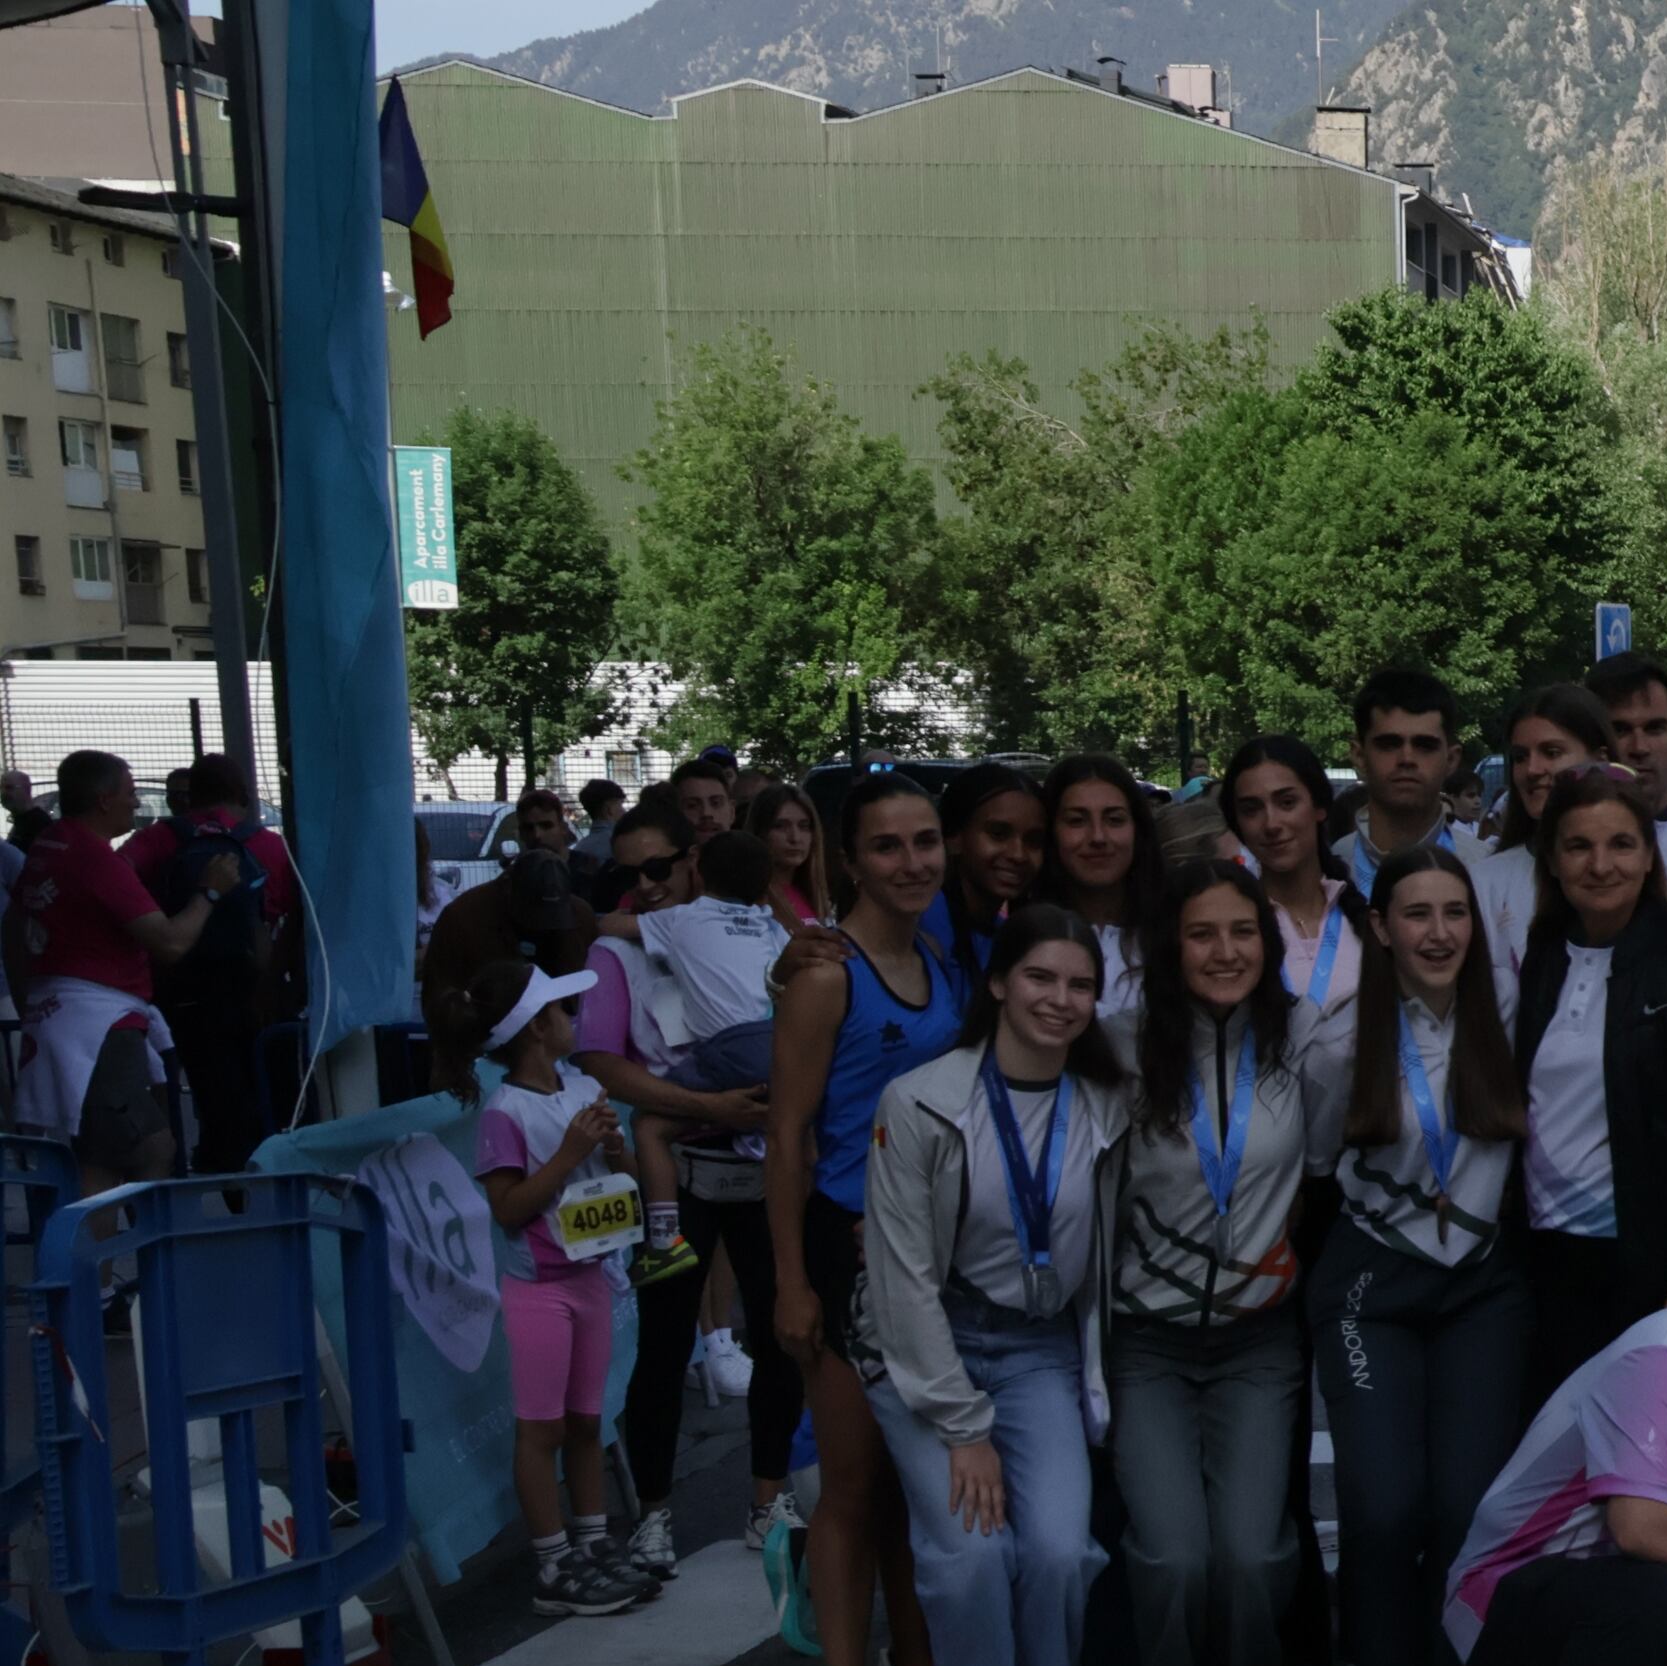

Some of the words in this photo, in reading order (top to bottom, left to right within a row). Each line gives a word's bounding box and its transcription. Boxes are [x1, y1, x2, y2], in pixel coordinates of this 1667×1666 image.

[409, 468, 431, 569] Aparcament
[429, 453, 447, 542] Carlemany
[572, 1198, 629, 1234] 4048
